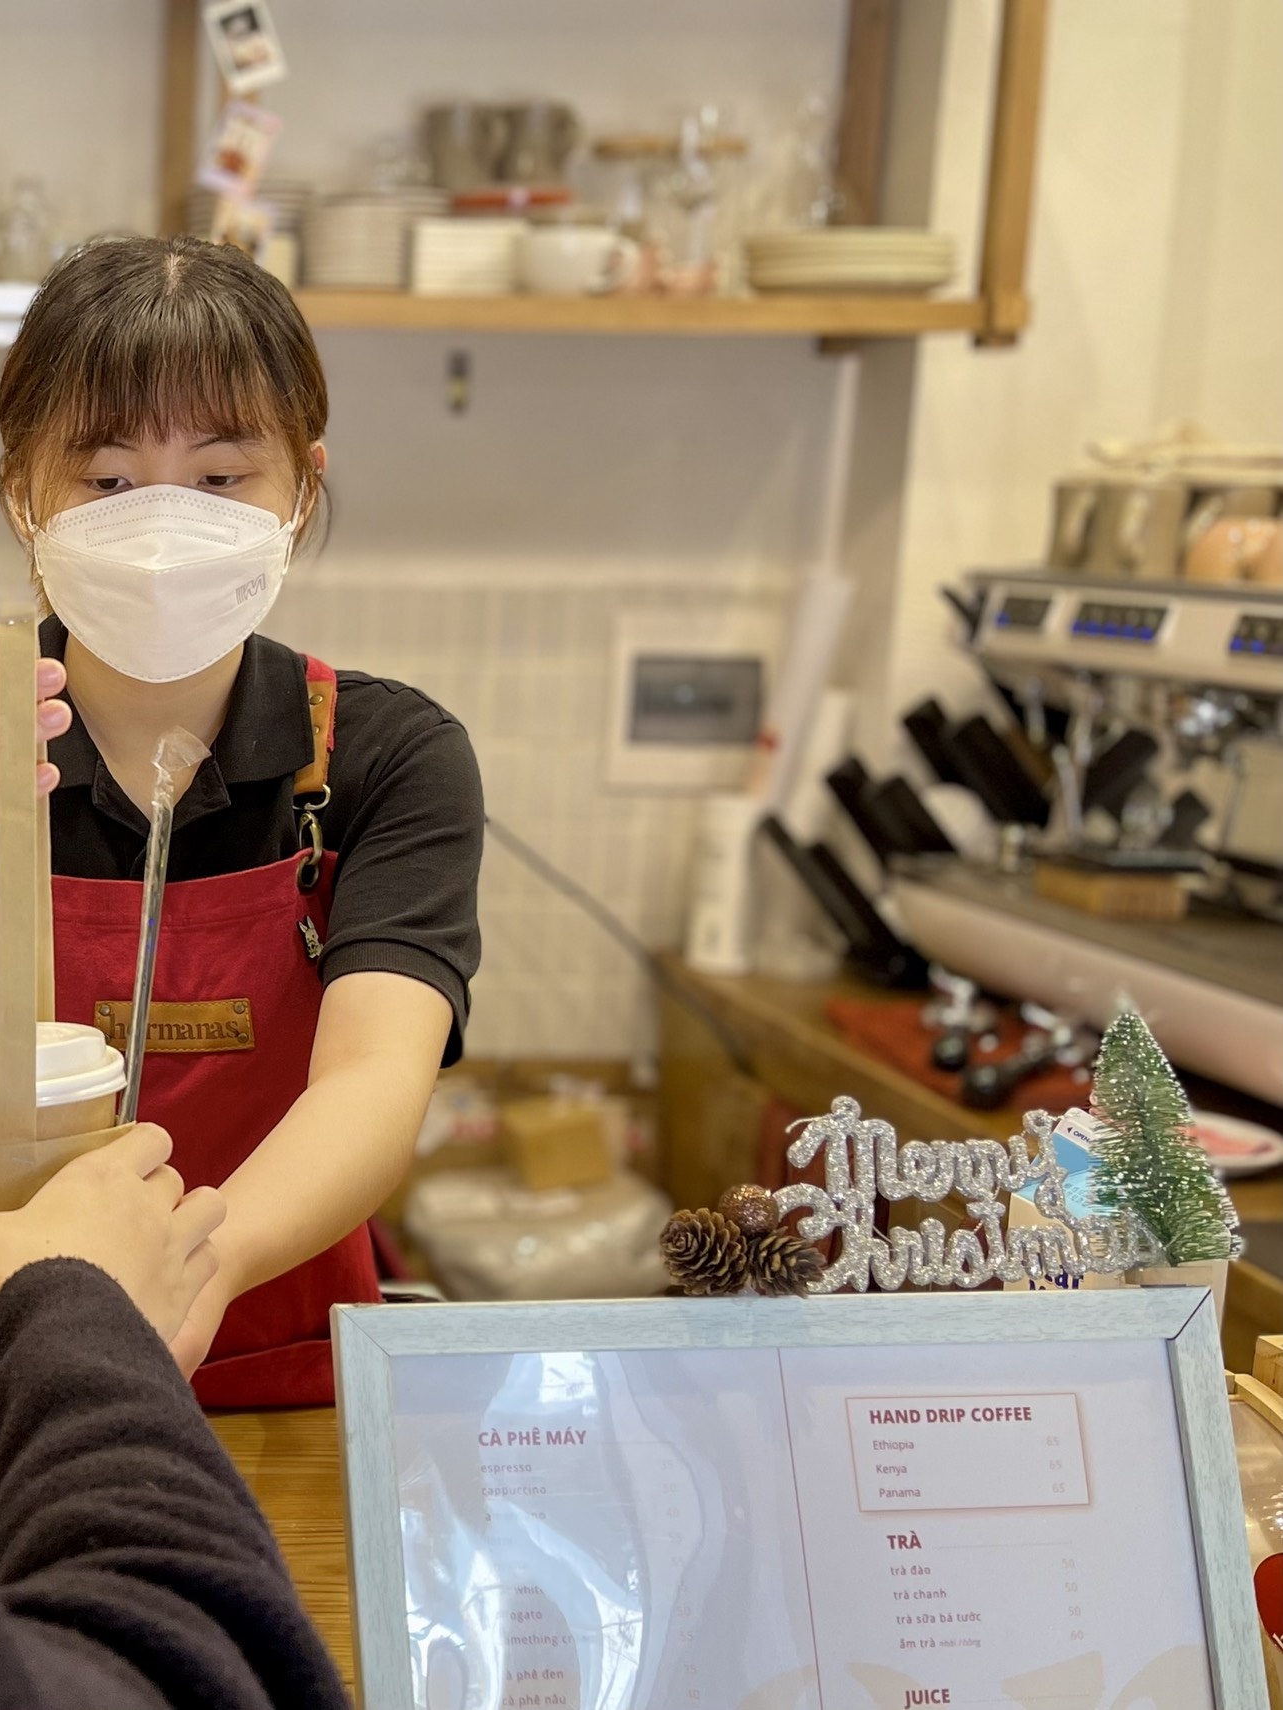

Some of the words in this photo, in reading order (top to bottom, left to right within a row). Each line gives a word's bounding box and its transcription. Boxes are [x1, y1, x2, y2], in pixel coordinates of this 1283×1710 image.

[109, 1014, 241, 1040] hrmanas
[787, 1096, 1066, 1221] Merry
[869, 1409, 922, 1425] HAND
[926, 1408, 966, 1423] DRIP
[970, 1406, 1033, 1422] COFFEE
[478, 1428, 502, 1448] CÀ
[507, 1427, 541, 1446] PHÊ
[546, 1426, 587, 1446] MÁY
[872, 1439, 915, 1453] Ethiopia
[480, 1463, 532, 1475] espresso
[875, 1463, 907, 1477] Kenya
[481, 1484, 547, 1498] cappuccino
[879, 1487, 921, 1499] Panama
[886, 1530, 922, 1551] TRÀ
[890, 1564, 907, 1576] trà
[910, 1564, 931, 1576] đào
[893, 1588, 910, 1601] trà
[913, 1587, 947, 1600] chanh
[896, 1612, 913, 1625] trà
[939, 1611, 953, 1624] bá
[919, 1637, 936, 1649] trà
[517, 1669, 538, 1683] phê
[541, 1669, 564, 1680] đen
[502, 1695, 515, 1706] cà
[518, 1694, 541, 1709] phê
[544, 1693, 566, 1706] nâu
[904, 1687, 951, 1709] JUICE
